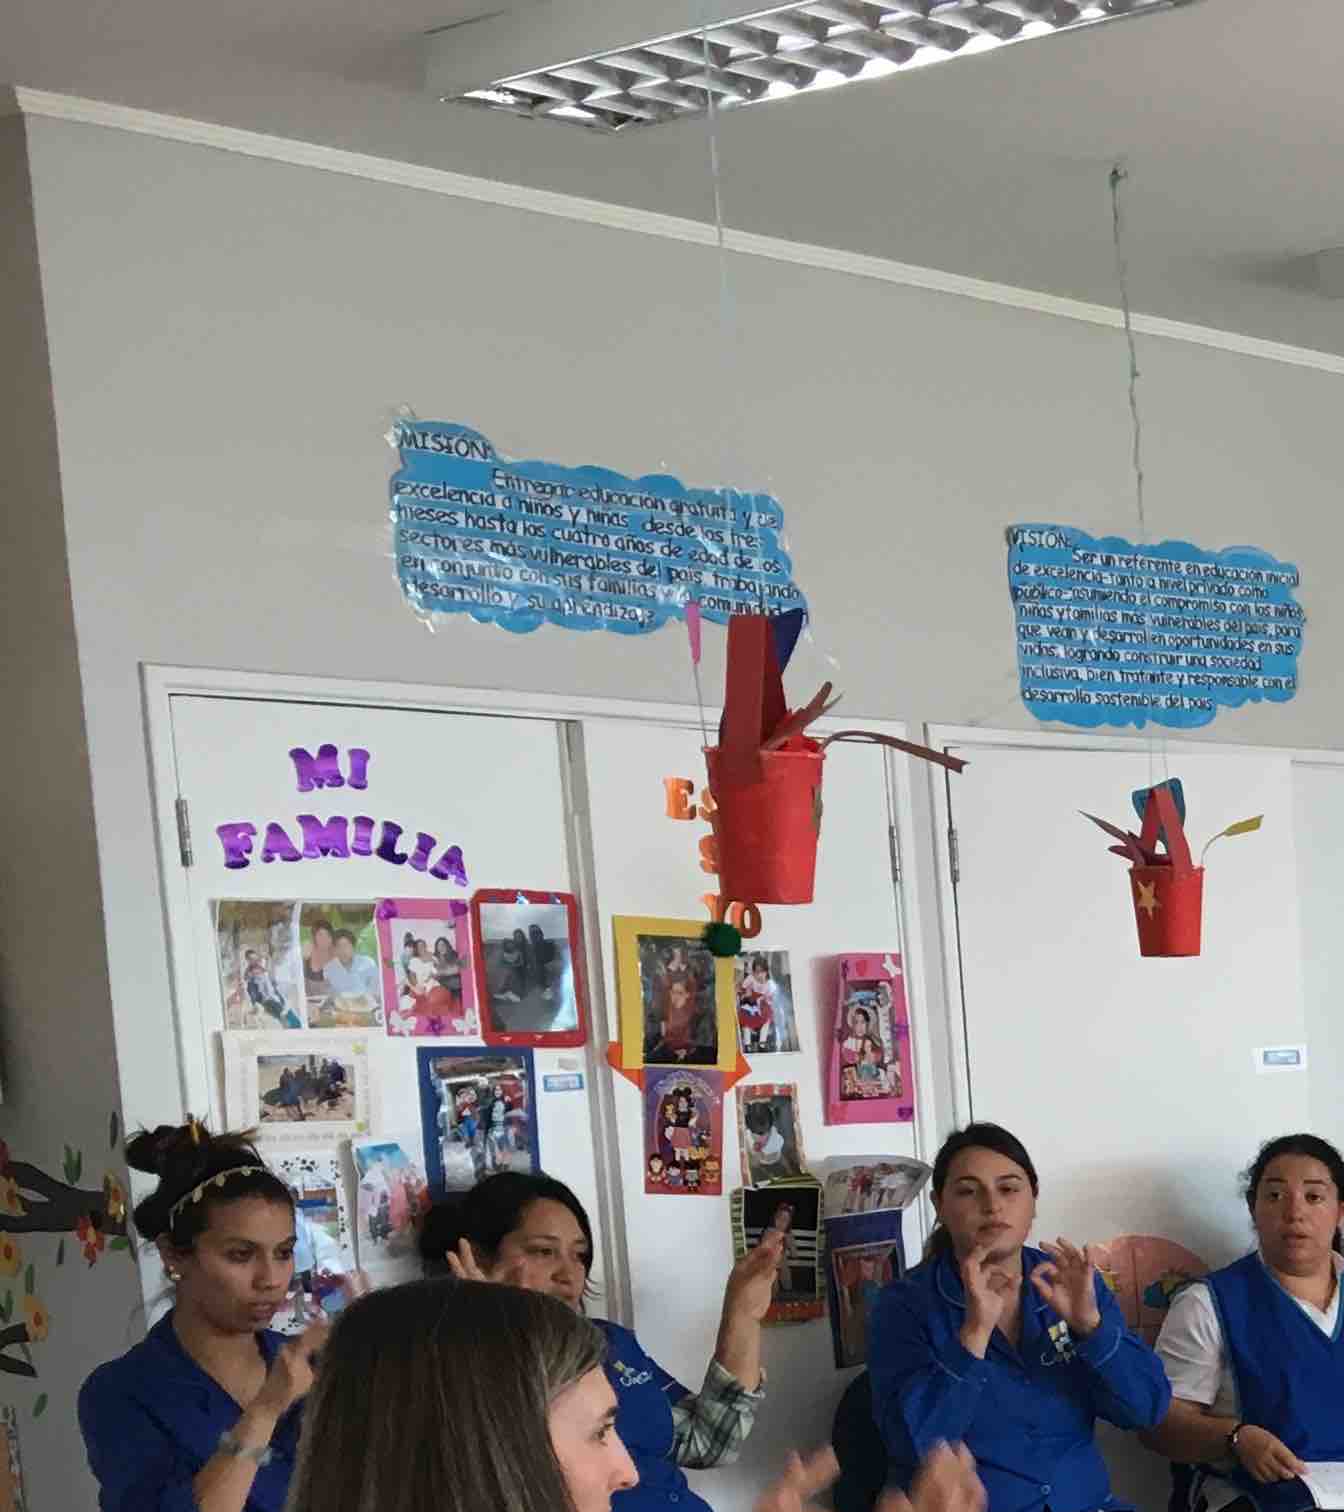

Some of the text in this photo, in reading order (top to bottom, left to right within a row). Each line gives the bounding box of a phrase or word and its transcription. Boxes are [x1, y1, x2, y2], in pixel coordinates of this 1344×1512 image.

[394, 481, 496, 507] excelencia
[502, 495, 512, 509] a
[568, 507, 580, 526] y
[641, 514, 695, 537] desde
[399, 527, 484, 553] sectores
[527, 547, 632, 577] vulnerables
[464, 509, 517, 533] hasta
[523, 519, 546, 538] los
[551, 526, 611, 548] cuatro
[659, 539, 683, 559] de
[734, 549, 754, 571] de
[1012, 560, 1030, 576] de
[1071, 545, 1096, 562] Ser
[1100, 552, 1117, 566] un
[1118, 553, 1182, 574] referente
[1185, 562, 1200, 576] en
[1152, 595, 1227, 614] compromiso
[1254, 603, 1272, 617] los
[1018, 623, 1041, 640] que
[1167, 635, 1256, 653] oportunidades
[1275, 643, 1295, 656] sus
[1064, 646, 1121, 663] logrando
[1021, 686, 1092, 704] desarrollo
[1187, 673, 1259, 691] responsable
[289, 744, 370, 792] MI
[216, 815, 470, 887] FAMILIA
